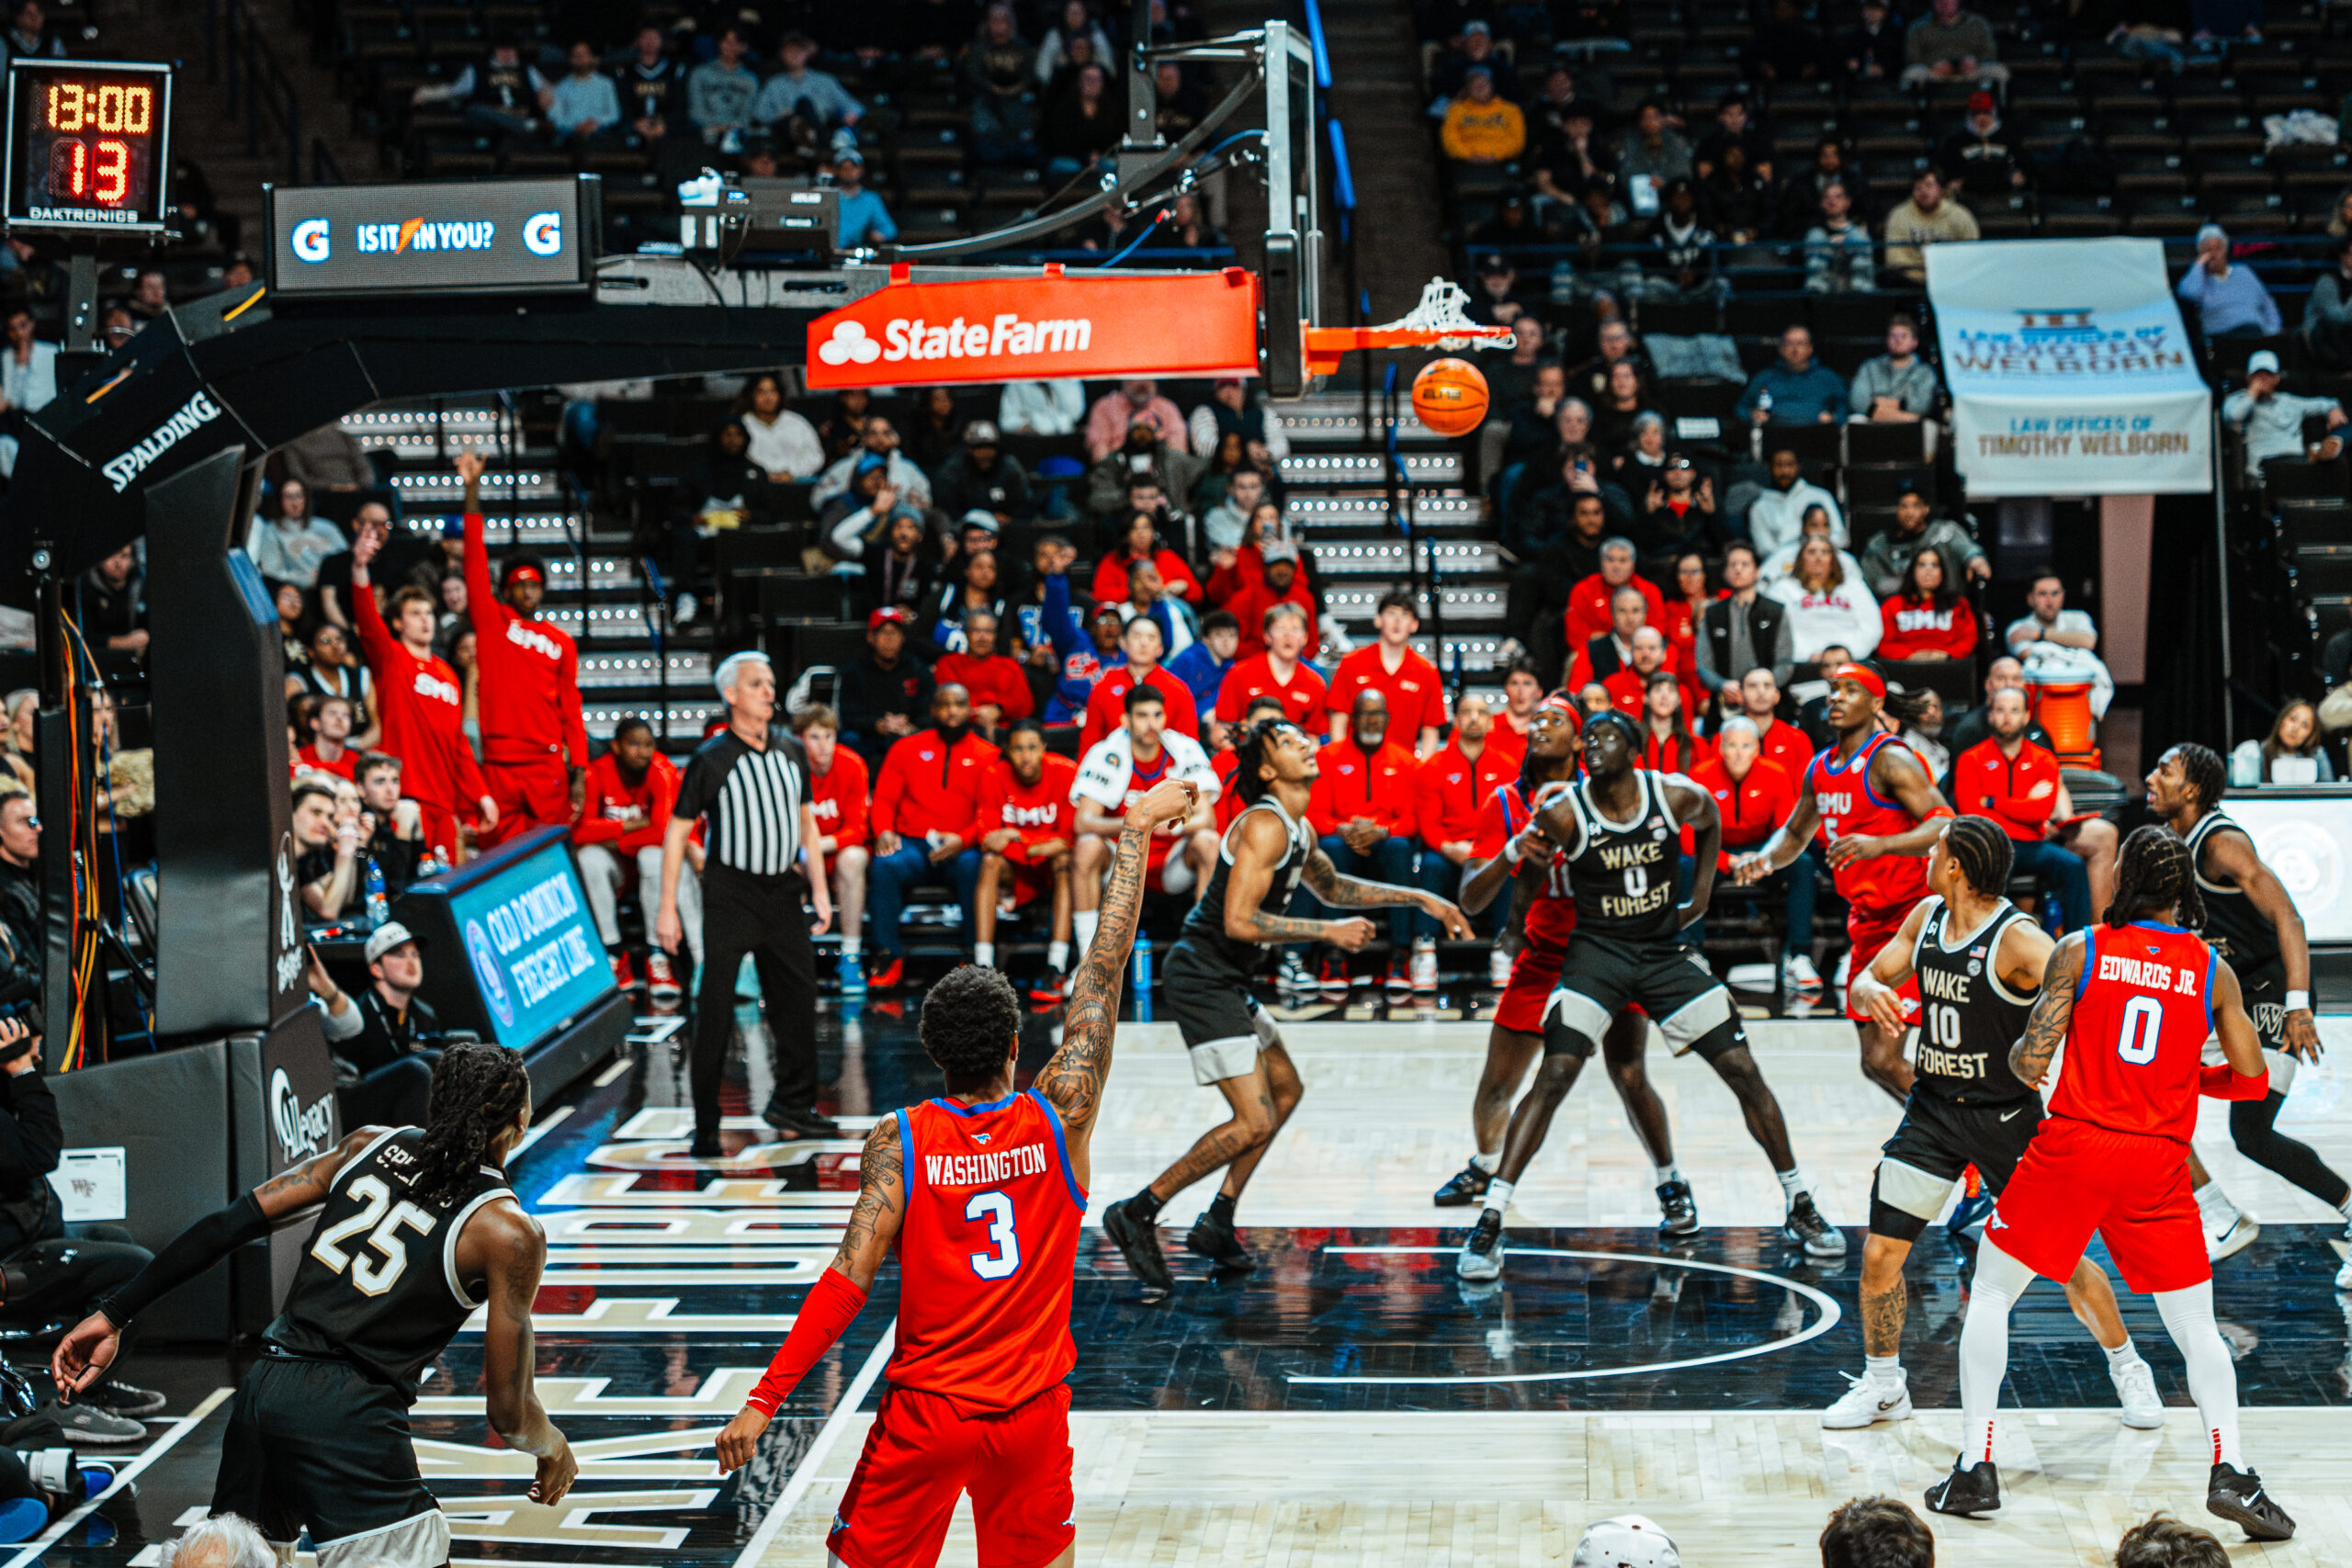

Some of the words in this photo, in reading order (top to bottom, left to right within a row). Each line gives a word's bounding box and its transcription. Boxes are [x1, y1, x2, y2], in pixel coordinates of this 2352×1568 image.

[49, 84, 151, 133] 13:00
[73, 141, 128, 201] 13
[29, 207, 138, 223] DAKTRONICS
[523, 211, 561, 256] G
[291, 218, 331, 263] G
[101, 390, 221, 494] SPALDING
[1978, 433, 2072, 457] TIMOTHY
[2079, 432, 2189, 457] WELBORN
[2009, 416, 2050, 434] LAW
[2054, 414, 2127, 434] OFFICES
[2132, 412, 2153, 432] OF
[1001, 802, 1057, 827] SMU
[1816, 791, 1852, 816] SMU
[1600, 841, 1664, 870] WAKE
[1623, 864, 1648, 898] 0
[1922, 965, 1972, 1004] WAKE
[2098, 954, 2172, 991] EDWARDS
[2174, 968, 2197, 997] JR.
[1928, 1002, 1962, 1049] 10
[2116, 994, 2164, 1066] 0
[1917, 1043, 1989, 1080] FOREST
[924, 1143, 1047, 1186] WASHINGTON
[310, 1174, 438, 1298] 25
[964, 1189, 1023, 1283] 3
